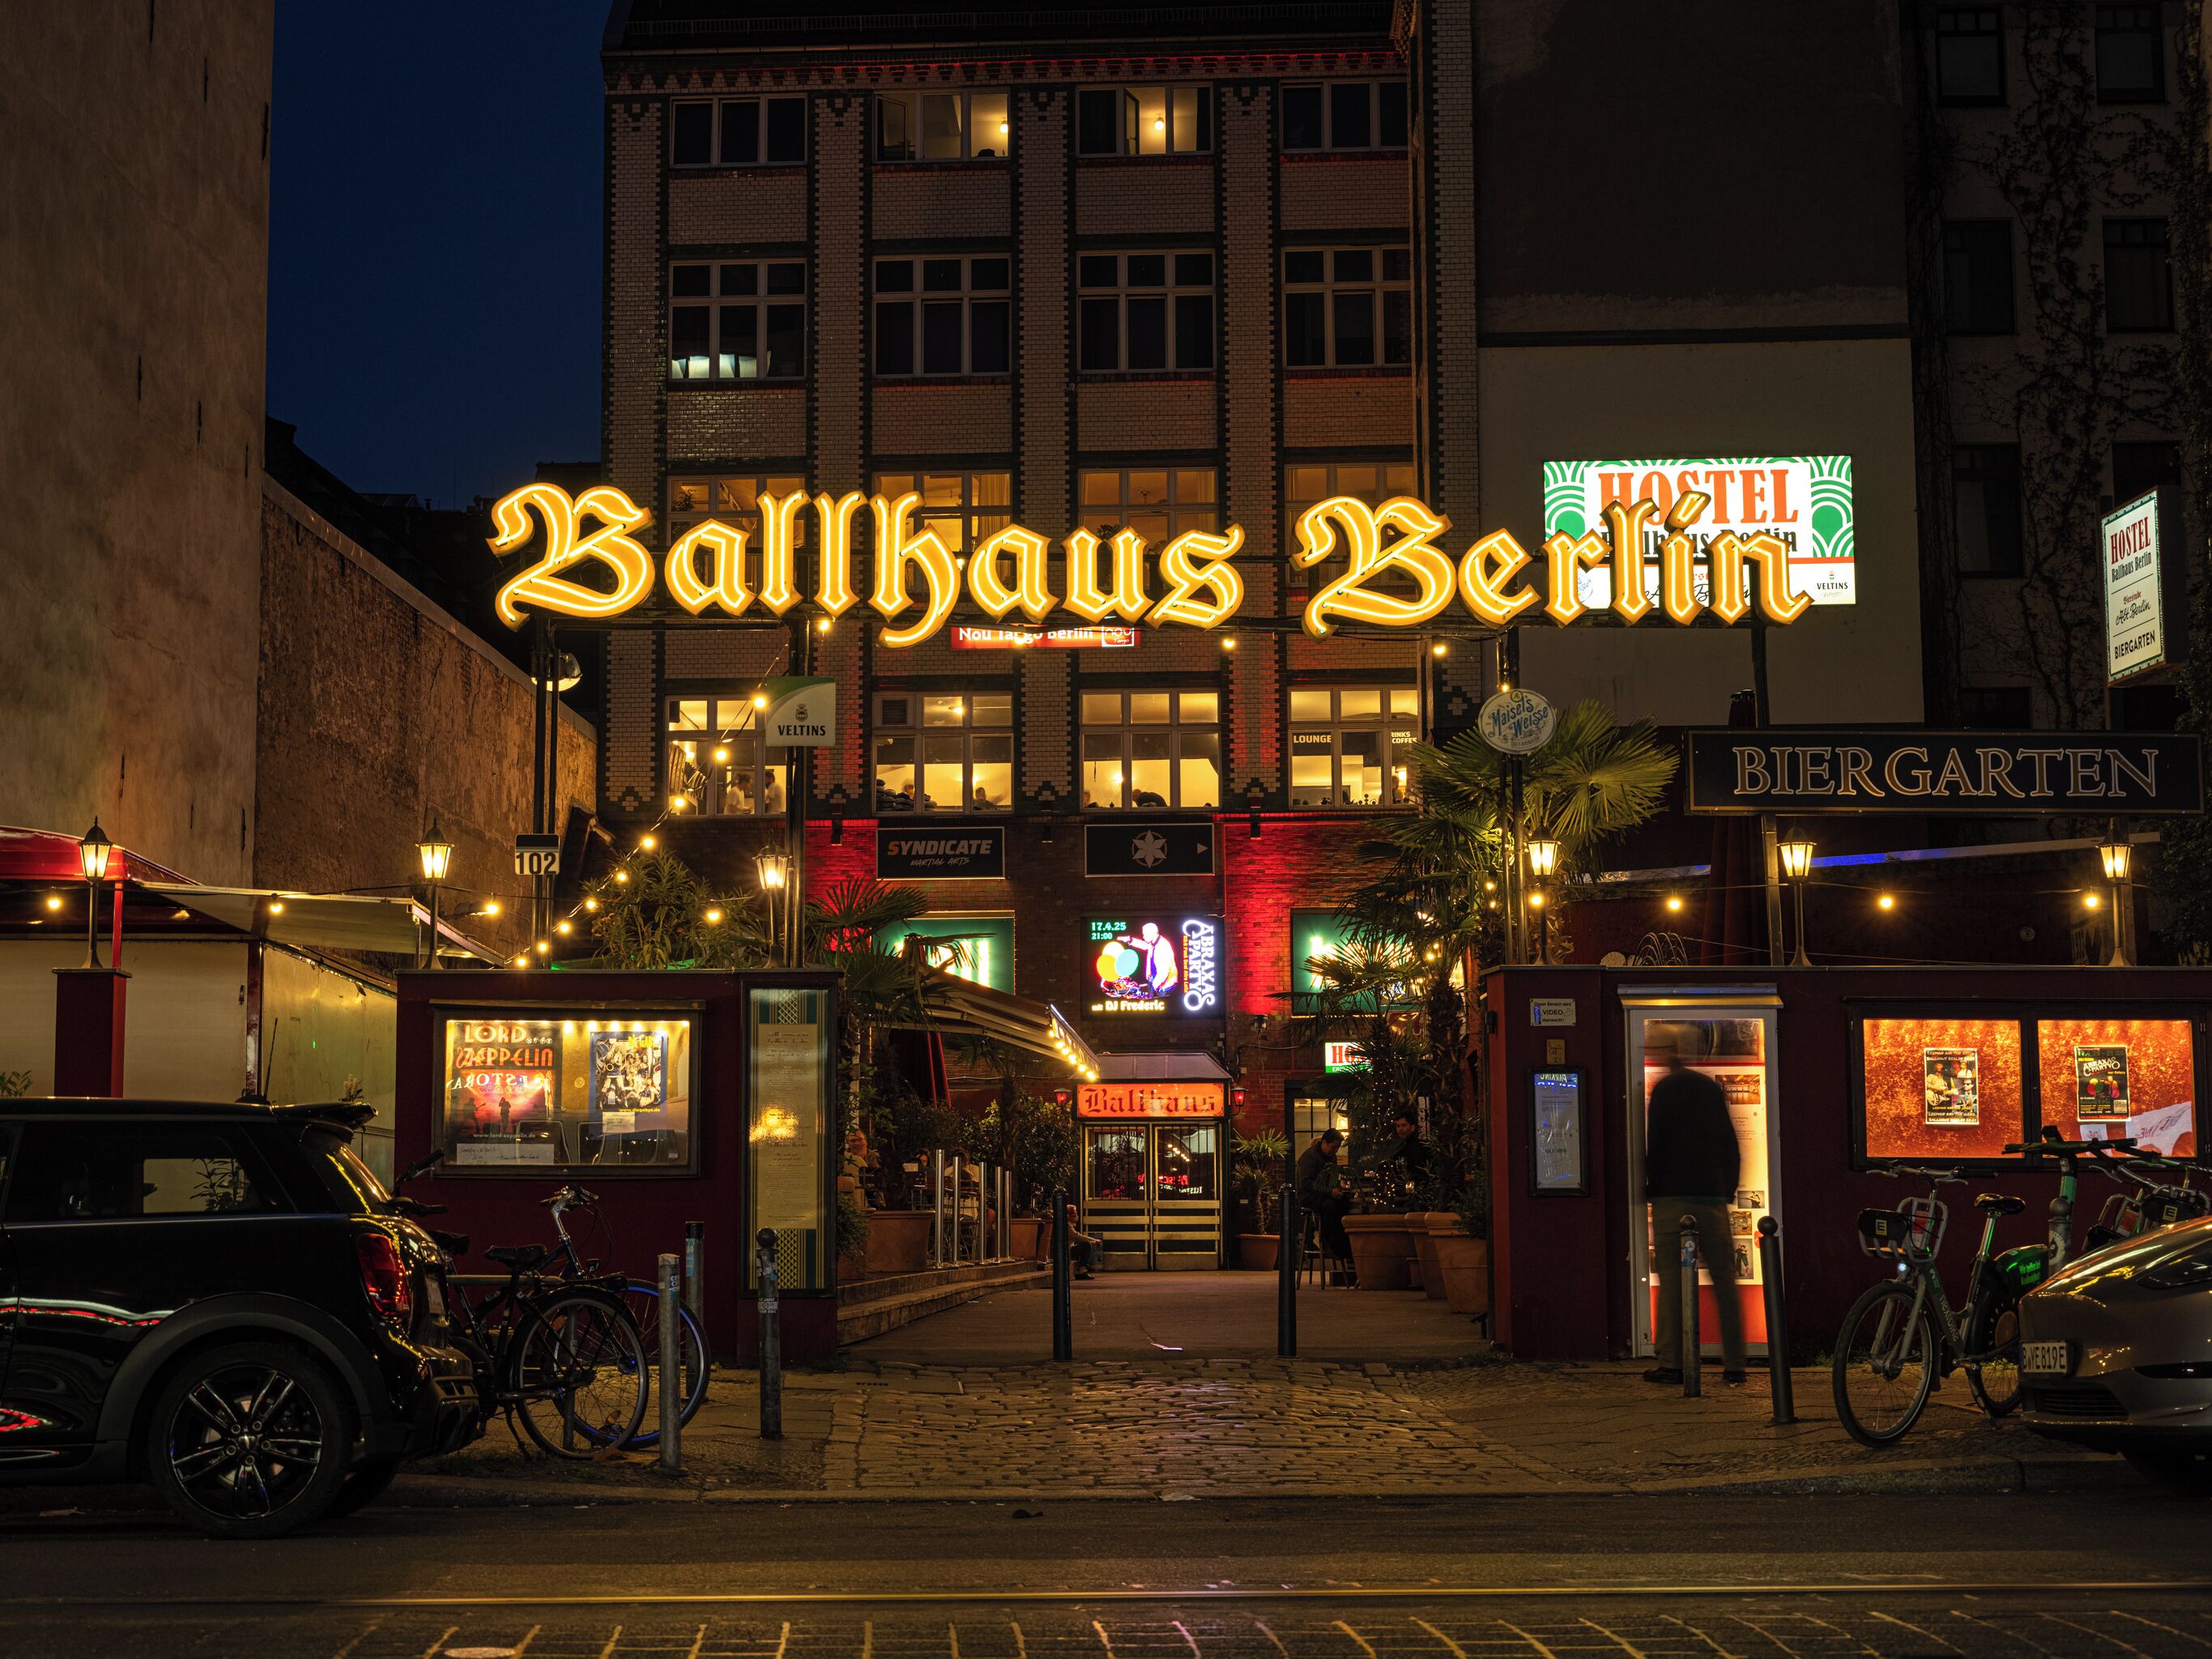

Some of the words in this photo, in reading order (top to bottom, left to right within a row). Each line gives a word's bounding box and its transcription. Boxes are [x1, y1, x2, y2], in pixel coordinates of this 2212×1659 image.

[1598, 469, 1798, 526] HOSTEL
[2111, 517, 2151, 564] HOSTEL
[486, 481, 1244, 648] Ballhaus
[1288, 491, 1815, 638] Berlin
[2112, 561, 2133, 582] Ballhaus
[2135, 552, 2152, 570] Berlin
[2116, 606, 2130, 626] Alt
[2129, 599, 2151, 619] Berlin
[959, 627, 991, 641] Nou
[2114, 631, 2155, 659] BIERGARTEN
[1488, 695, 1534, 738] Maisel's
[1508, 706, 1549, 739] Weisse
[778, 725, 826, 736] VELTINS
[1294, 735, 1332, 744] LOUNGE
[1733, 746, 2159, 797] BIERGARTEN
[888, 839, 993, 856] SYNDICATE
[516, 852, 556, 875] 102
[910, 858, 945, 868] MARTIAL
[948, 857, 970, 867] ARTS
[1091, 922, 1127, 932] 17.4.25
[1183, 919, 1216, 1011] ABRAXAS
[1188, 940, 1202, 992] PARTY
[1106, 1001, 1118, 1010] DJ
[1120, 1000, 1165, 1010] Frederic
[464, 1024, 526, 1043] LORD
[456, 1047, 553, 1068] ZEPPELIN
[2083, 1056, 2120, 1077] ABRAXAS
[2091, 1062, 2112, 1073] PARTY
[1085, 1088, 1215, 1114] Ballhaus
